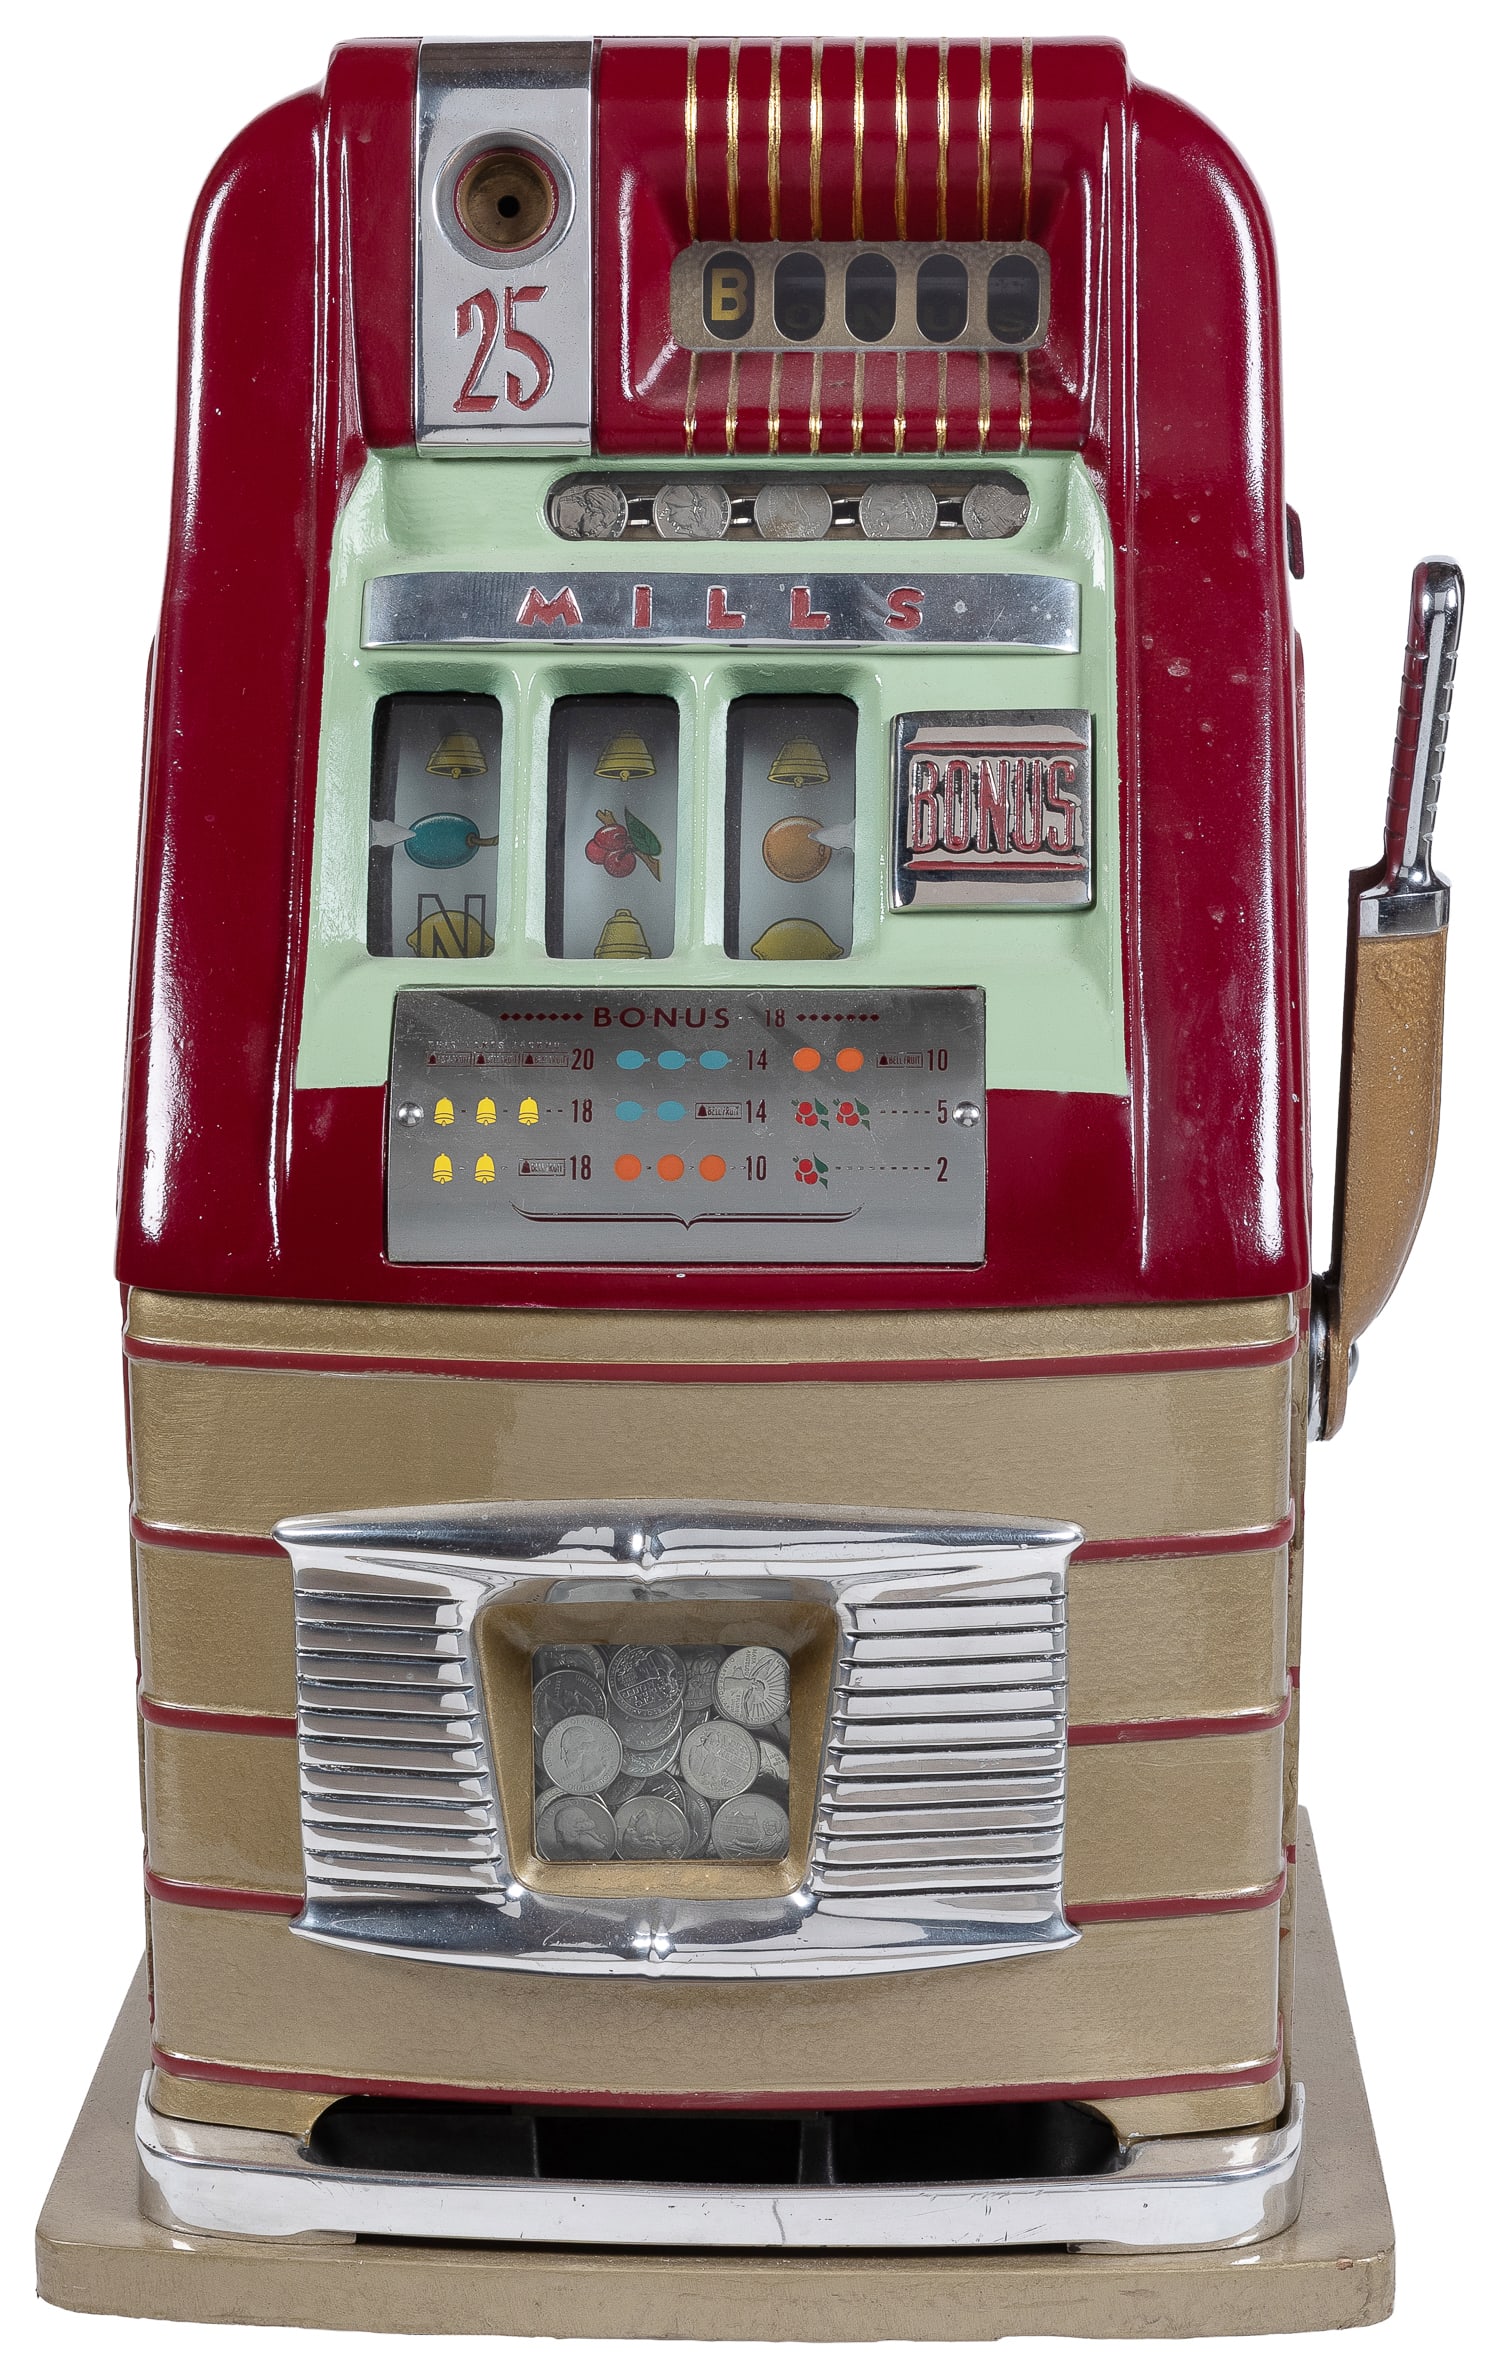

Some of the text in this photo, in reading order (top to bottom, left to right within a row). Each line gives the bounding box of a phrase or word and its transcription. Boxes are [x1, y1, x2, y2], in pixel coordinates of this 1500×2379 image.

[453, 285, 555, 414] 25
[515, 584, 926, 630] MILLS
[910, 758, 1078, 855] BONUS
[766, 1008, 786, 1029] 18
[571, 1047, 595, 1071] 20
[747, 1048, 768, 1071] 14
[927, 1047, 949, 1072] 10
[571, 1099, 593, 1124] 18
[746, 1098, 767, 1124] 14
[937, 1099, 949, 1124] 5
[570, 1155, 592, 1181] 18
[746, 1155, 767, 1181] 10
[937, 1156, 949, 1182] 2
